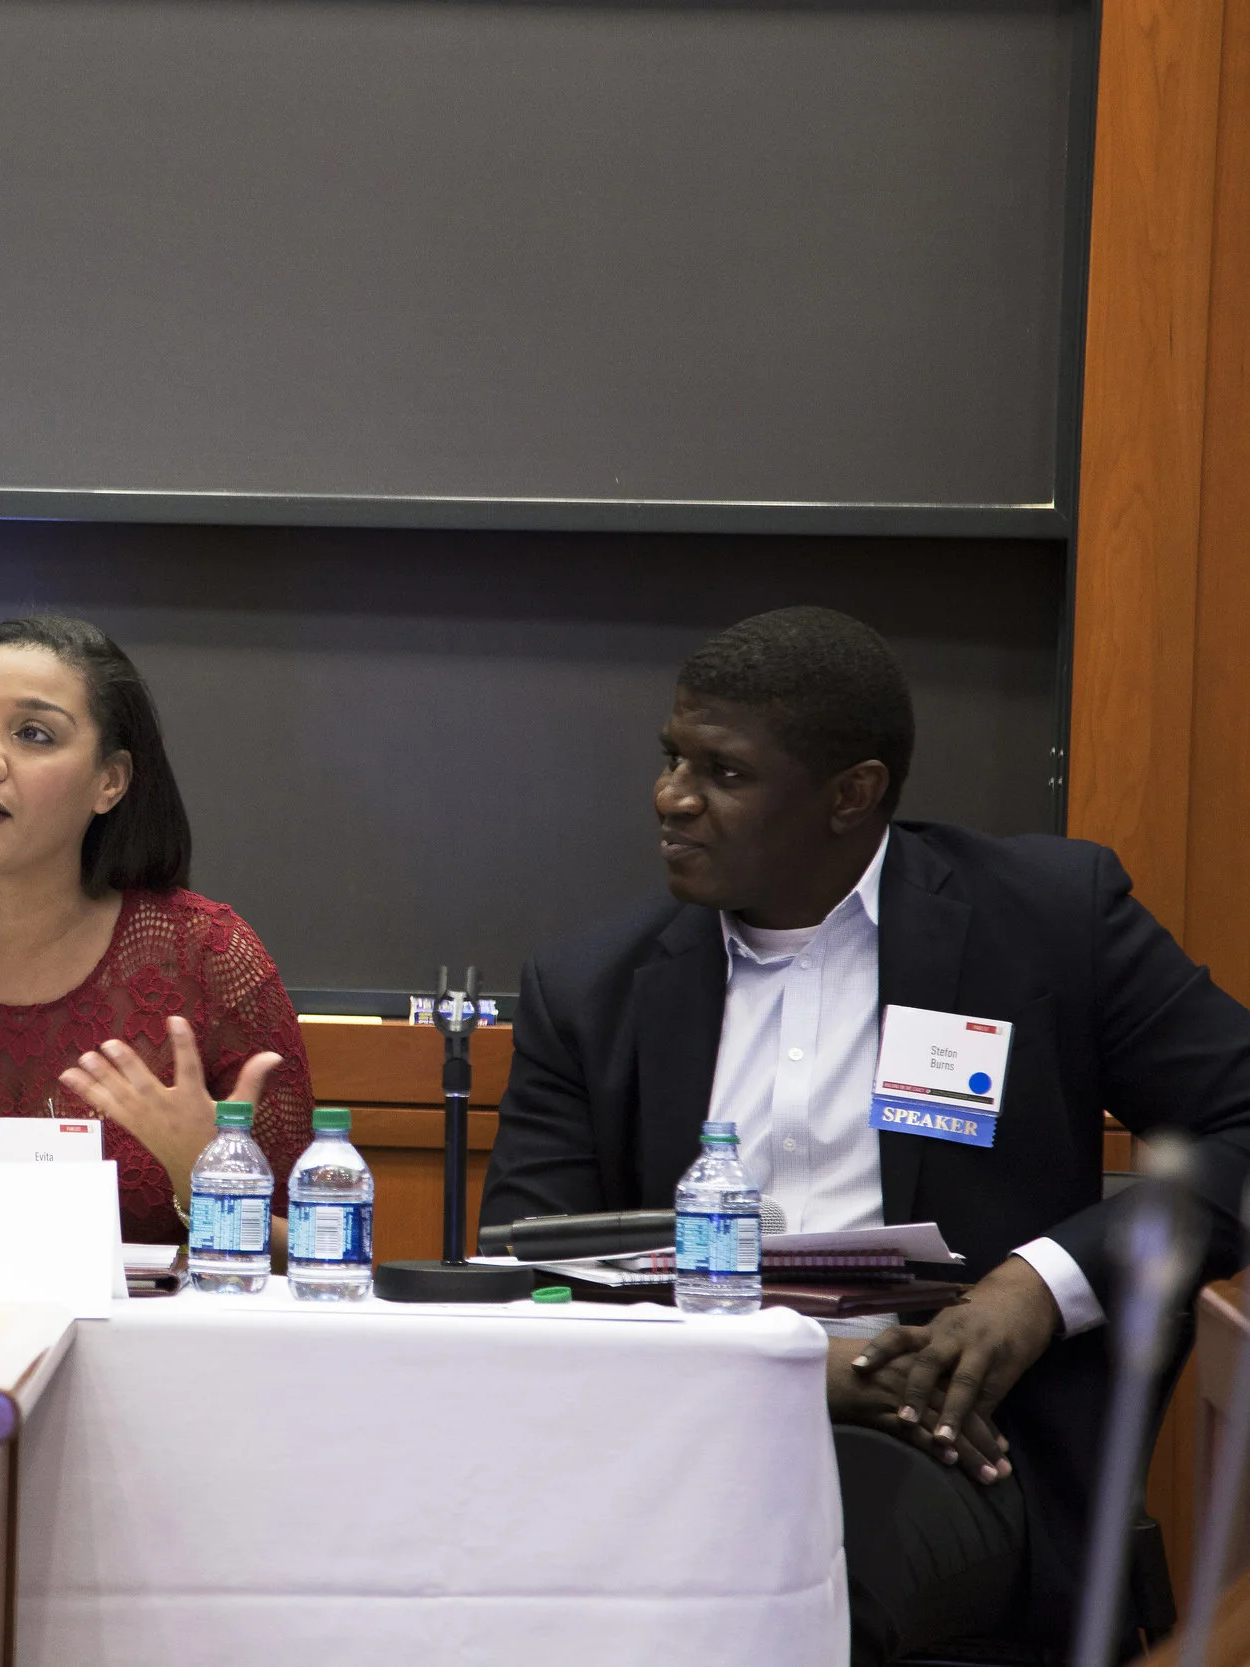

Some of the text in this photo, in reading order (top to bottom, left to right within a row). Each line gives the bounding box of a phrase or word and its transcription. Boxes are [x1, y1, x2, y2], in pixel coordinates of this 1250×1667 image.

[930, 1045, 958, 1058] Stefon
[930, 1059, 955, 1071] Burns
[882, 1106, 978, 1136] SPEAKER
[34, 1151, 54, 1162] Evita
